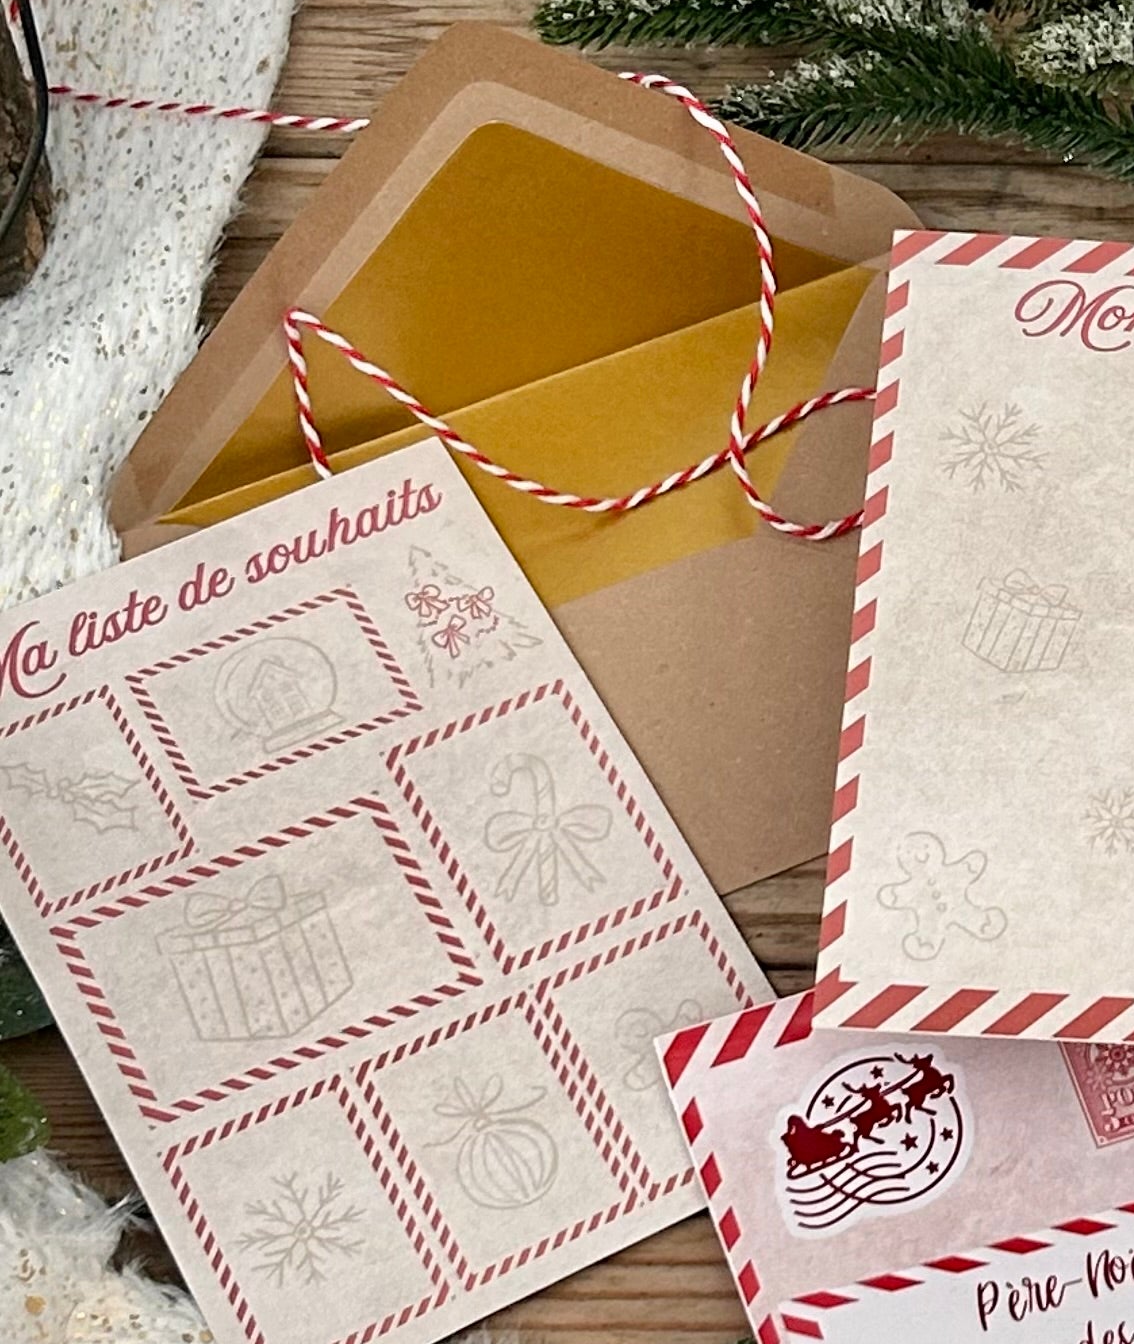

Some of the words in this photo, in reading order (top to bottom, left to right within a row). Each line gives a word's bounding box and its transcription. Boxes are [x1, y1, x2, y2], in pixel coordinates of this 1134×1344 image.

[69, 589, 168, 656] liste
[179, 563, 235, 611] de
[245, 479, 442, 583] souhaits
